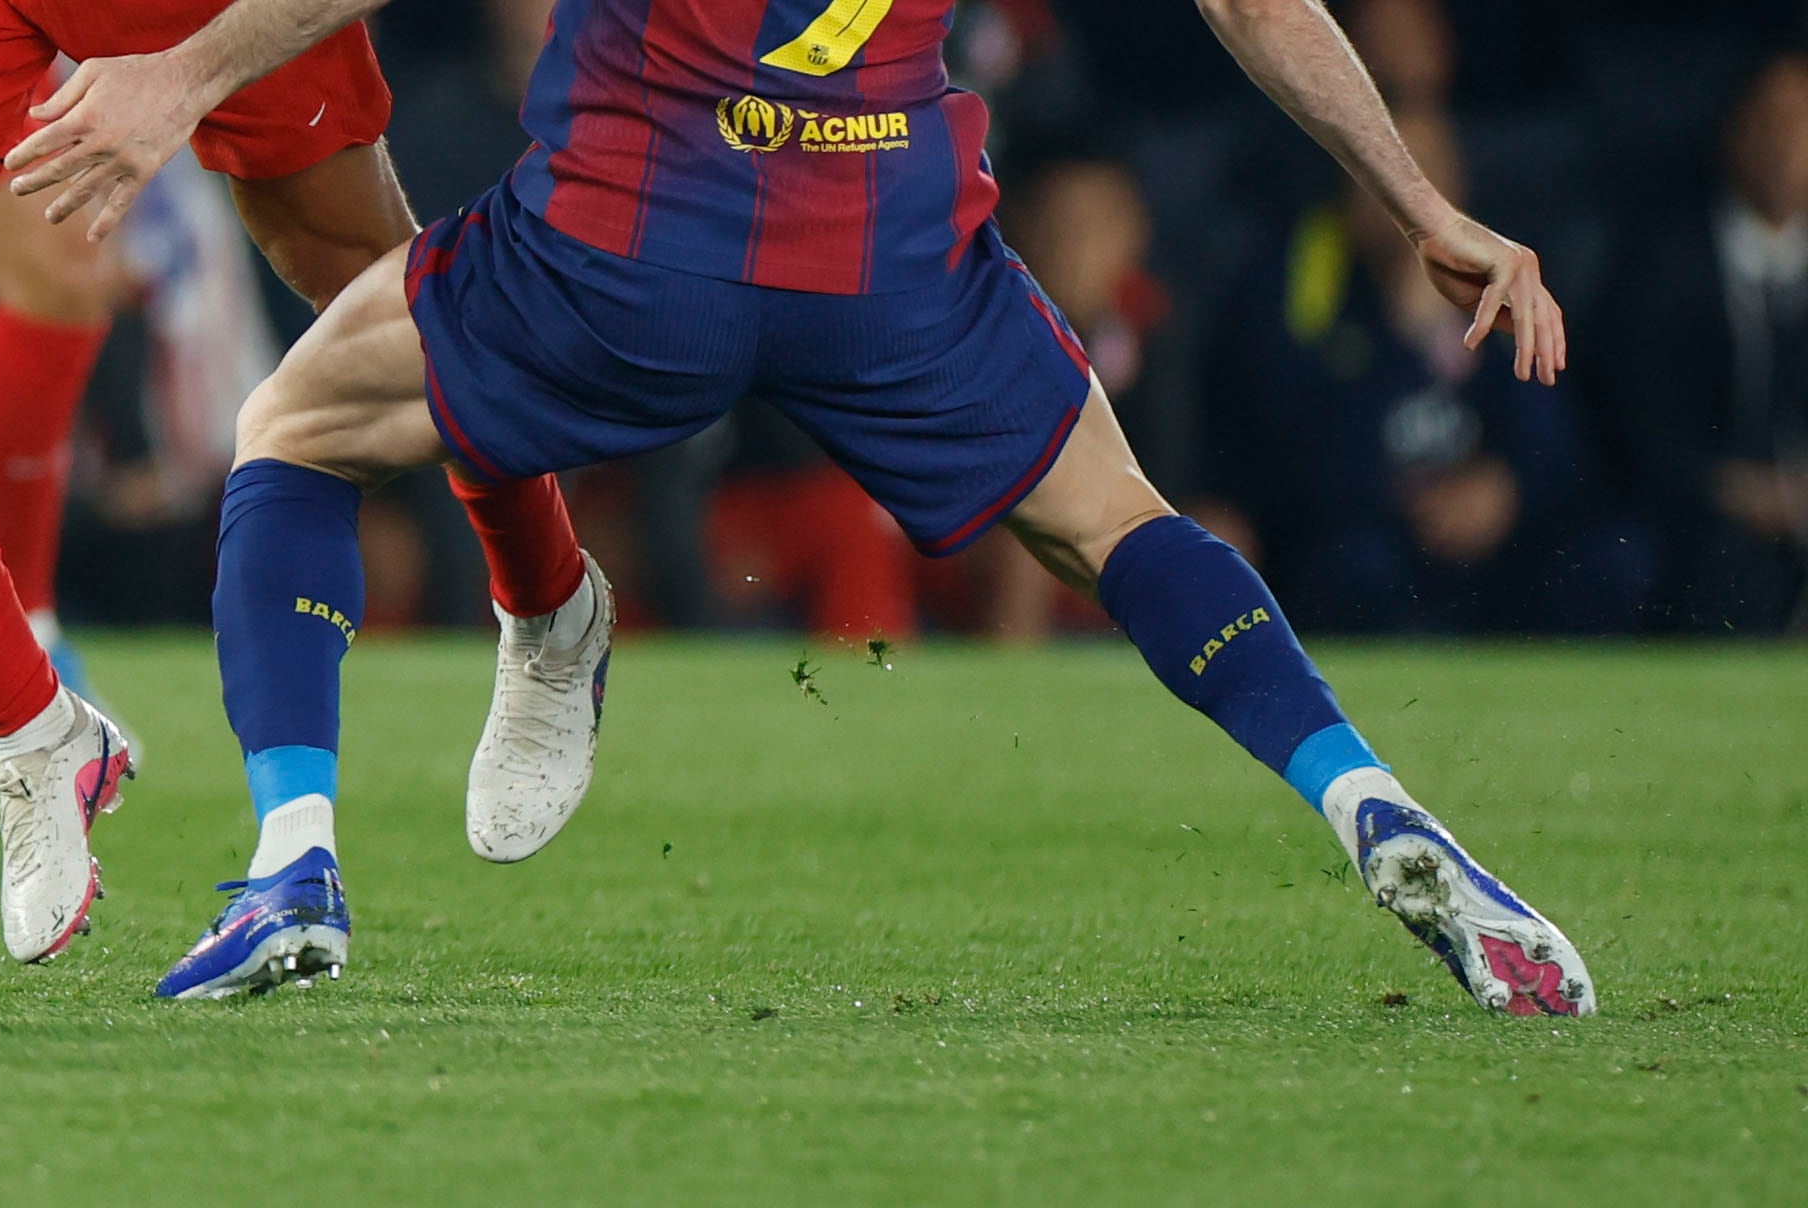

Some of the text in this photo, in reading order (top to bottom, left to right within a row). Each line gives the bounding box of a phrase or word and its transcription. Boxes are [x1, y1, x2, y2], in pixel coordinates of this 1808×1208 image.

[799, 111, 909, 142] ACNUR
[800, 139, 910, 154] The UN Refugee Agency
